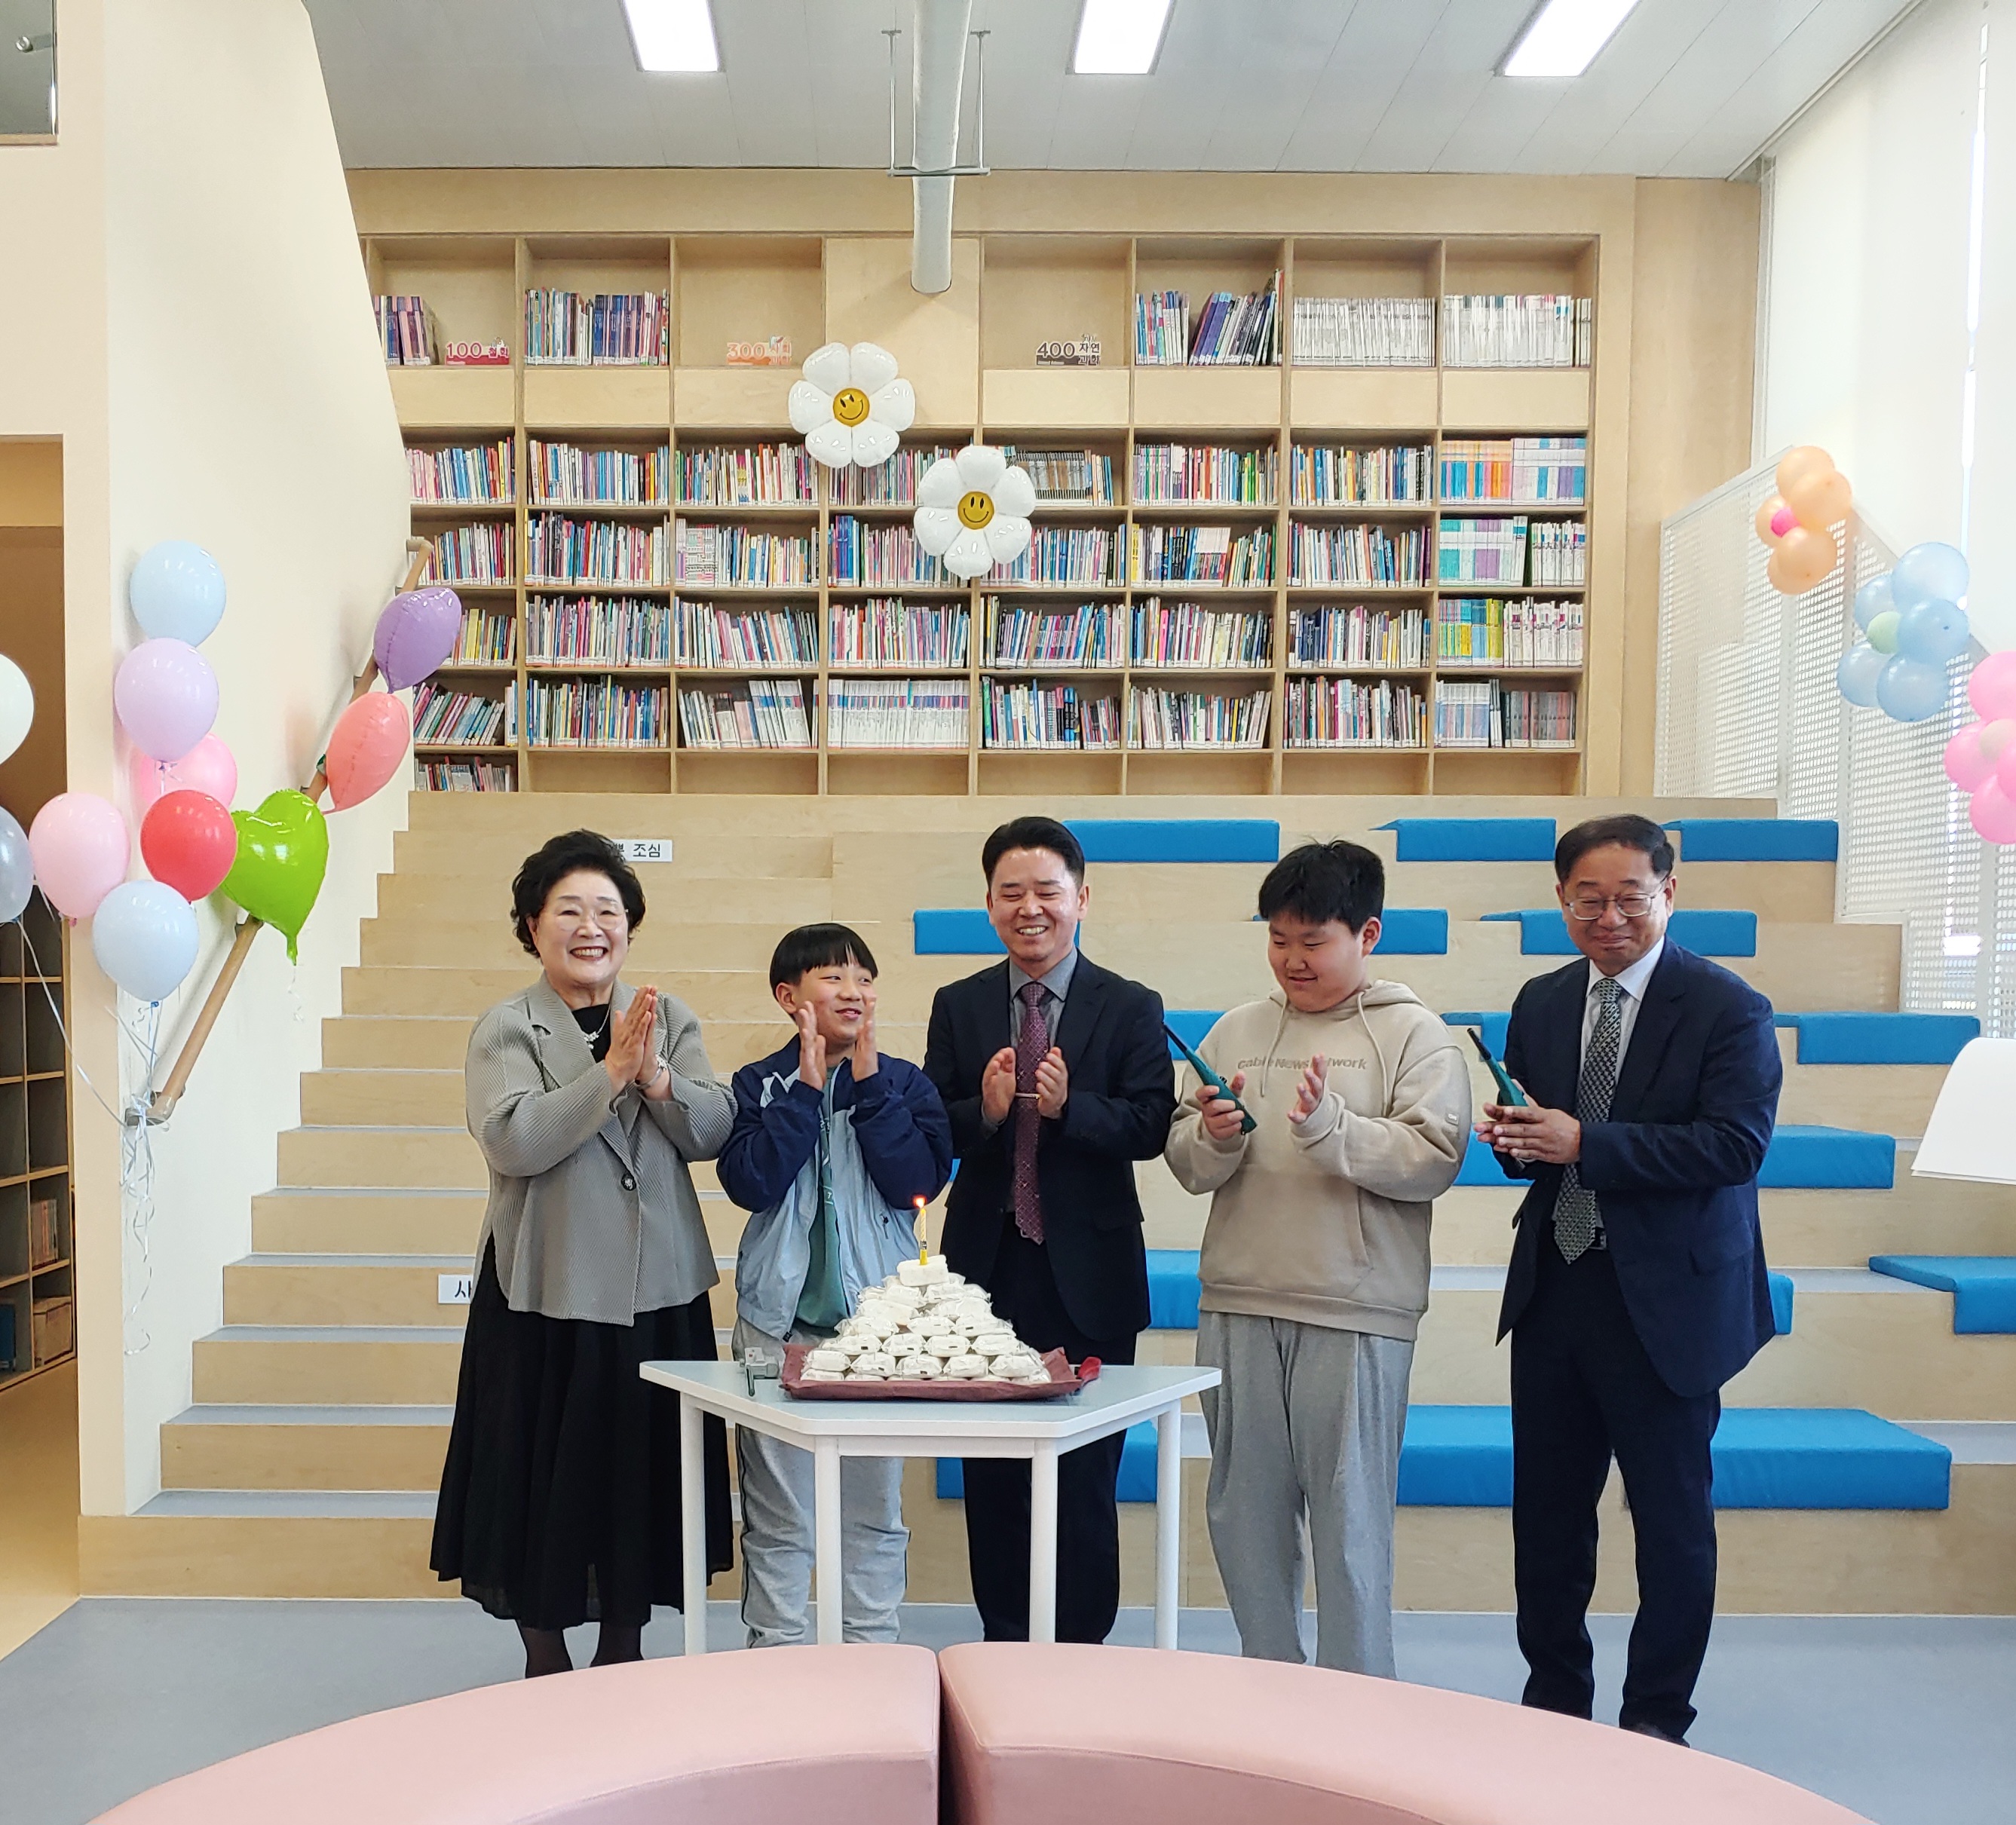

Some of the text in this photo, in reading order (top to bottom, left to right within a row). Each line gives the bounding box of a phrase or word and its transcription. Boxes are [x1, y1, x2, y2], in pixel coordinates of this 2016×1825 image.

[446, 342, 482, 357] 100
[728, 344, 766, 360] 300
[1037, 342, 1100, 357] 400 자연
[633, 844, 660, 858] 조심
